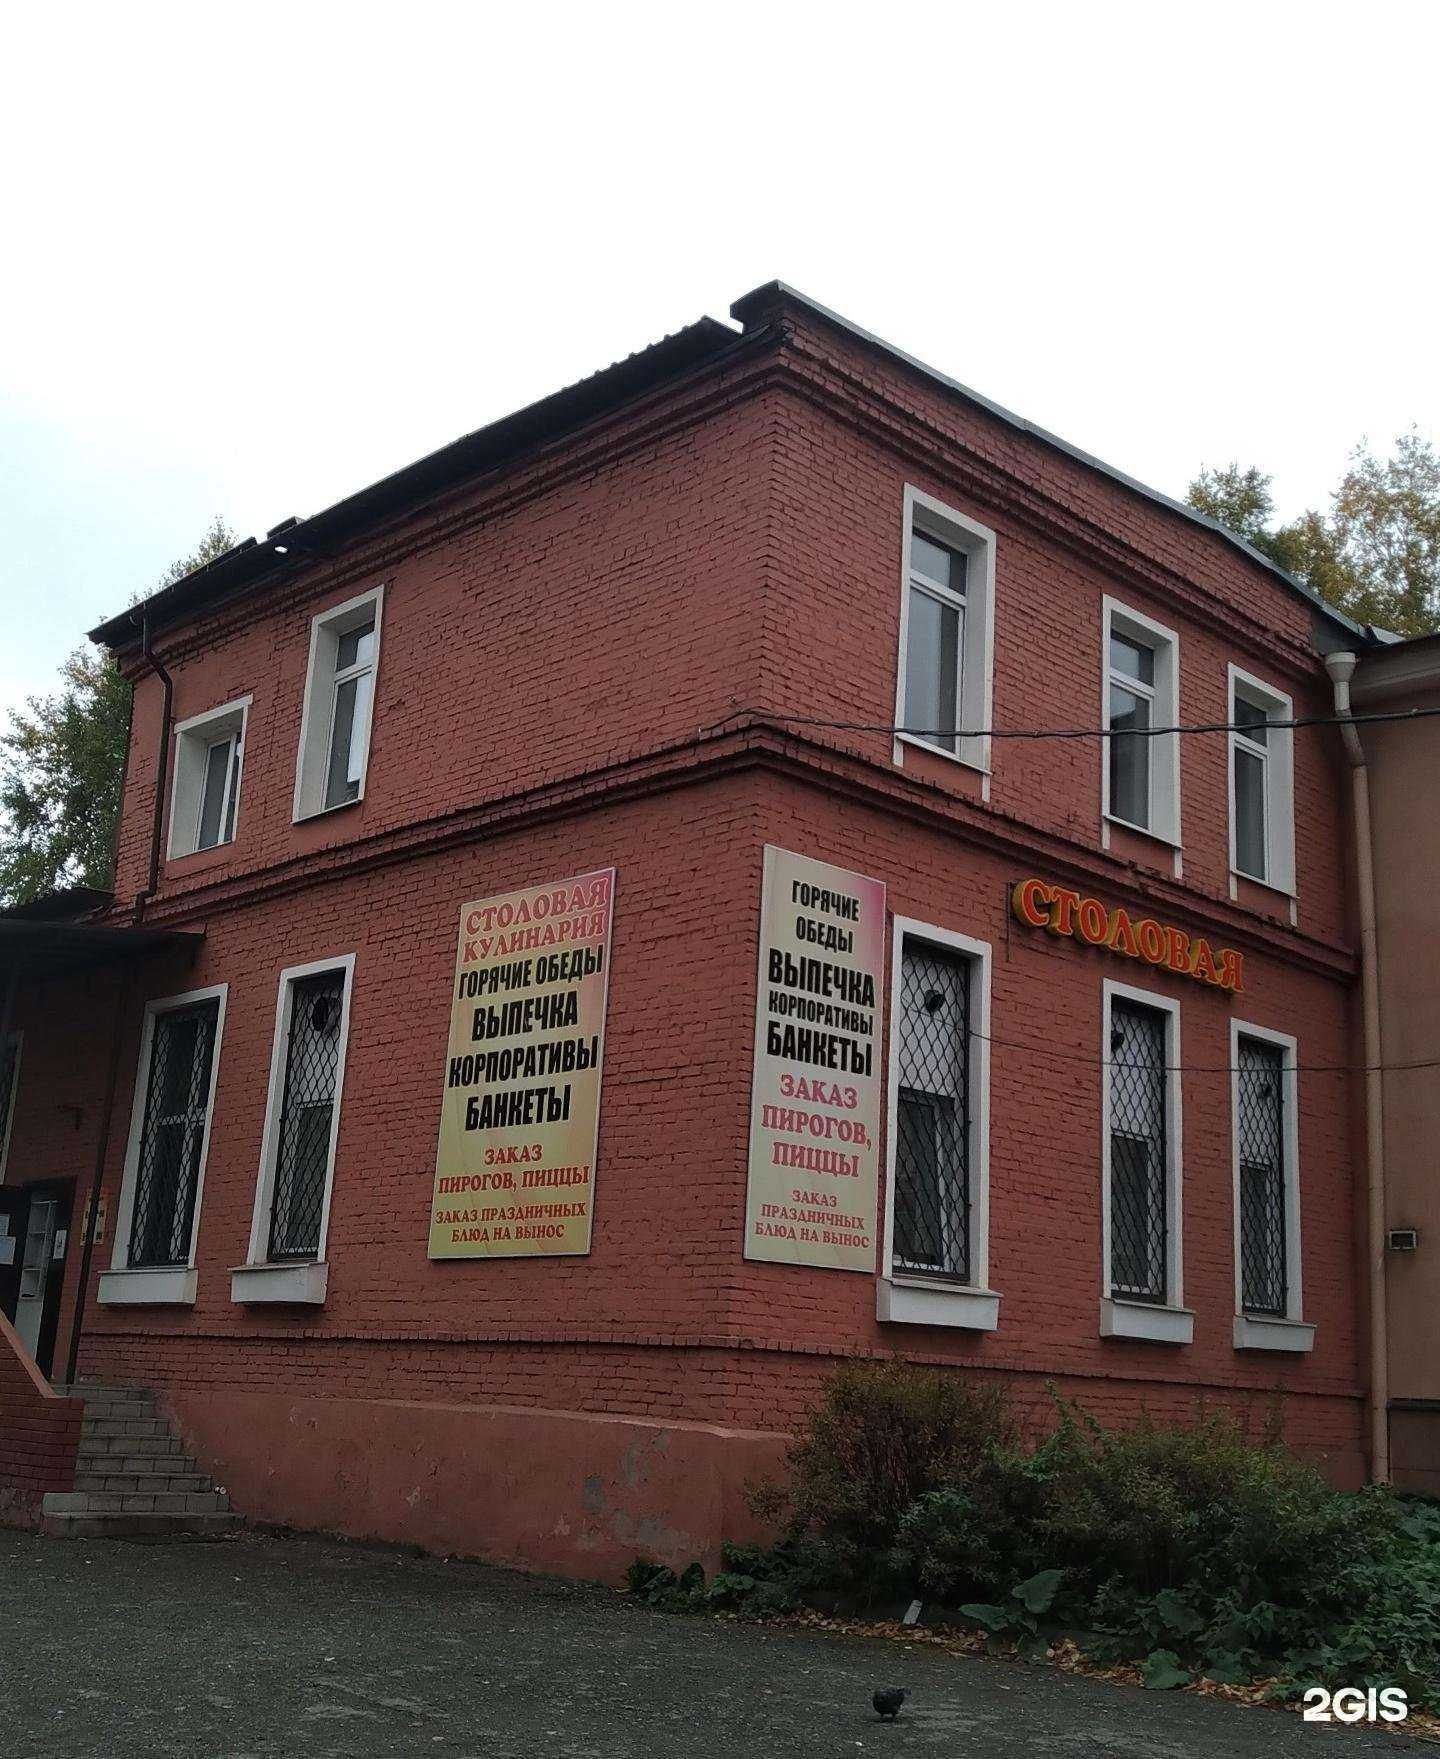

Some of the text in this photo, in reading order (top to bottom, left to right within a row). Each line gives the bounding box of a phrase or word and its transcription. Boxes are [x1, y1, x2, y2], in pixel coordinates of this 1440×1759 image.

[466, 878, 608, 936] СТОЛОВАЯ
[791, 880, 860, 922] ГОРЯЧИЕ
[462, 911, 606, 965] КУЛИНАРИЯ
[796, 915, 853, 953] ОБЕДЫ
[1012, 878, 1246, 993] СТОЛОВАЯ
[458, 945, 604, 999] ГОРЯЧИЕ ОБЕДЫ
[768, 948, 875, 1008] ВЫПЕЧКА
[471, 991, 578, 1041] ВЫПЕЧКА
[768, 990, 873, 1036] КОРПОРАТИВЫ
[448, 1036, 599, 1088] КОРПОРАТИВЫ
[767, 1020, 872, 1077] БАНКЕТЫ
[465, 1084, 571, 1131] БАНКЕТЫ
[780, 1074, 858, 1109] ЗАКАЗ
[761, 1105, 872, 1150] ПИРОГОВ,
[483, 1144, 543, 1165] ЗАКАЗ
[772, 1141, 860, 1178] ПИЦЦЫ
[438, 1165, 591, 1193] ПИРОГОВ, ПИЦЦЫ
[792, 1190, 837, 1208] ЗАКАЗ
[435, 1202, 586, 1224] ЗАКАЗ ПРАЗДНИЧНЫХ
[451, 1224, 565, 1243] БЛЮД НА ВЫНОС
[761, 1204, 864, 1230] ПРАЗДНИЧНЫХ
[755, 1222, 870, 1248] БЛЮД НА ВЫНОС
